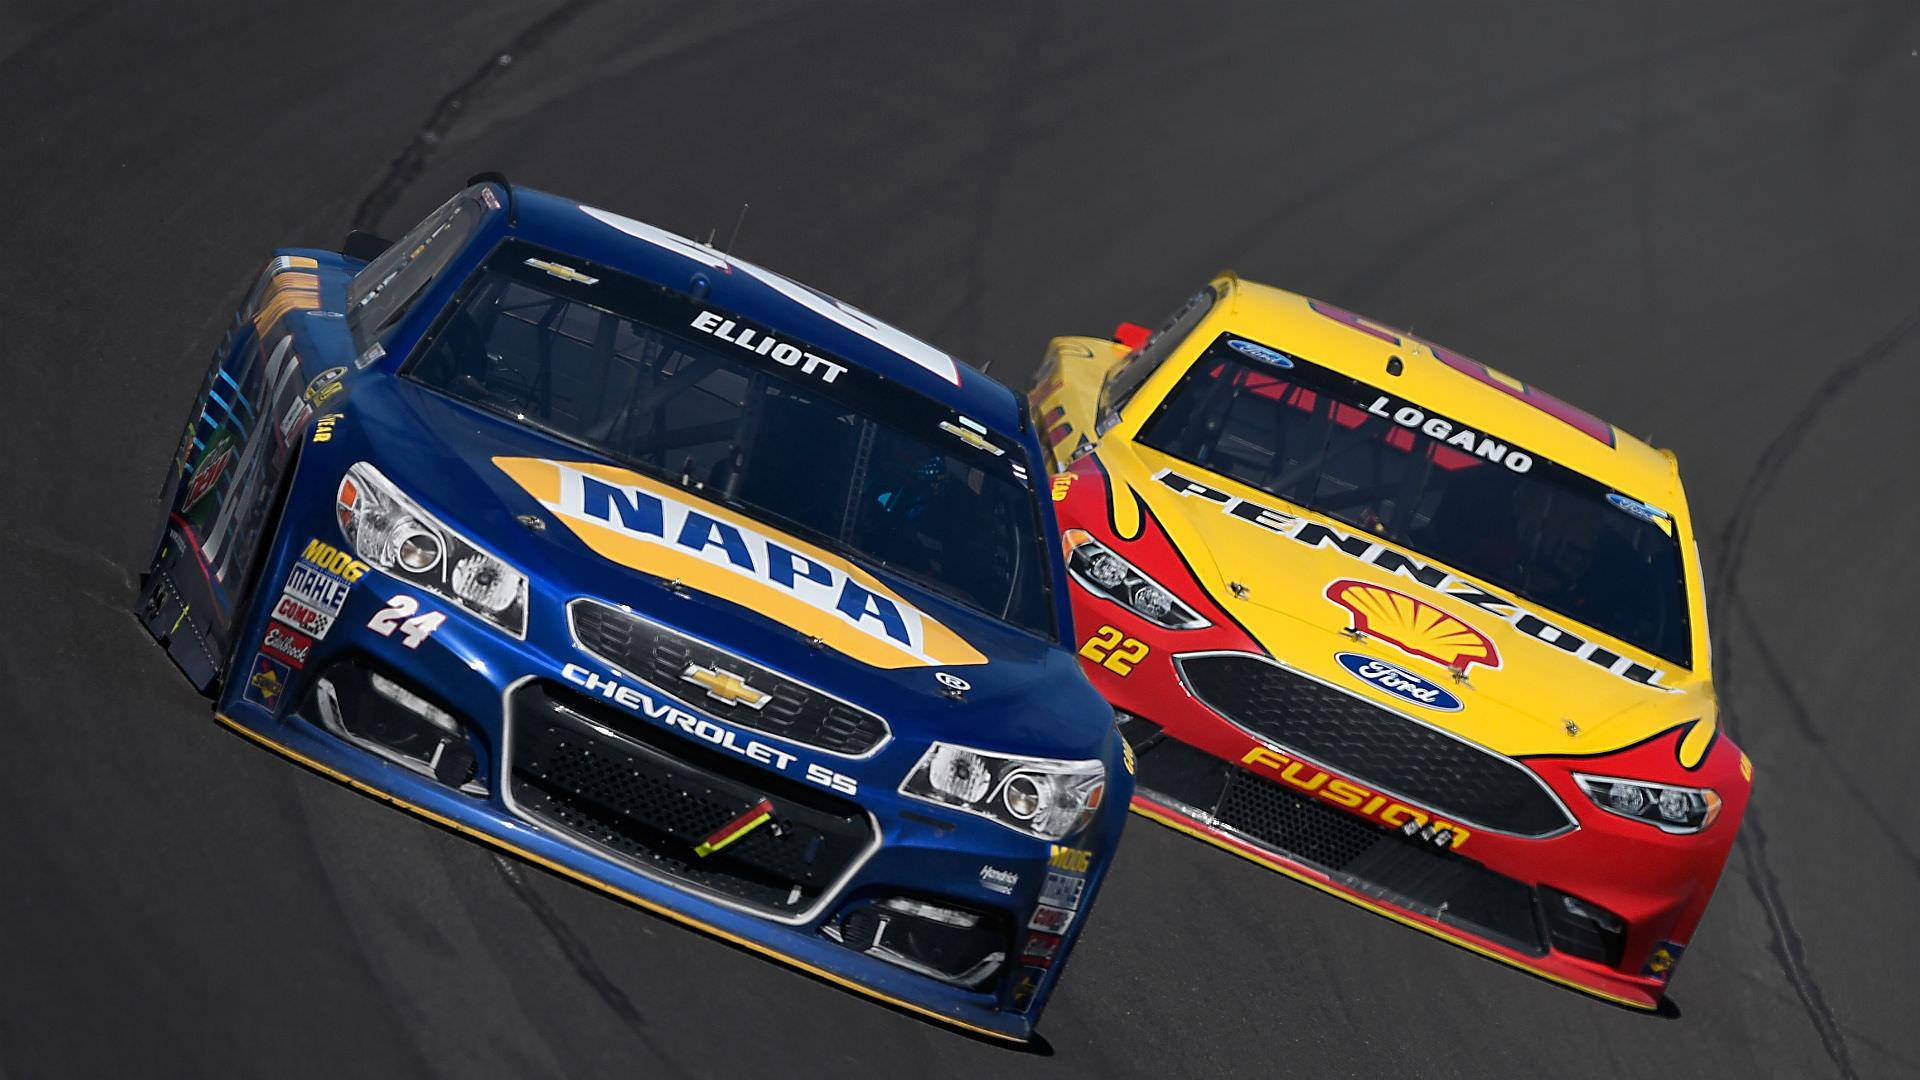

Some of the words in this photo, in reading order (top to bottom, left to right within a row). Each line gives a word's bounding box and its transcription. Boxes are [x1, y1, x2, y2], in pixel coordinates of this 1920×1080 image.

[690, 310, 848, 384] ELLIOTT
[1368, 396, 1533, 474] LOGANO
[301, 538, 371, 583] MOOG
[582, 475, 911, 648] NAPA
[1150, 467, 1687, 694] PENNZOIL
[277, 598, 317, 626] COMP
[287, 566, 346, 612] MAHLE
[367, 594, 448, 649] 24
[1079, 624, 1150, 677] 22
[1358, 660, 1441, 703] Ford
[560, 662, 798, 770] CHEVROLET
[805, 763, 858, 796] SS
